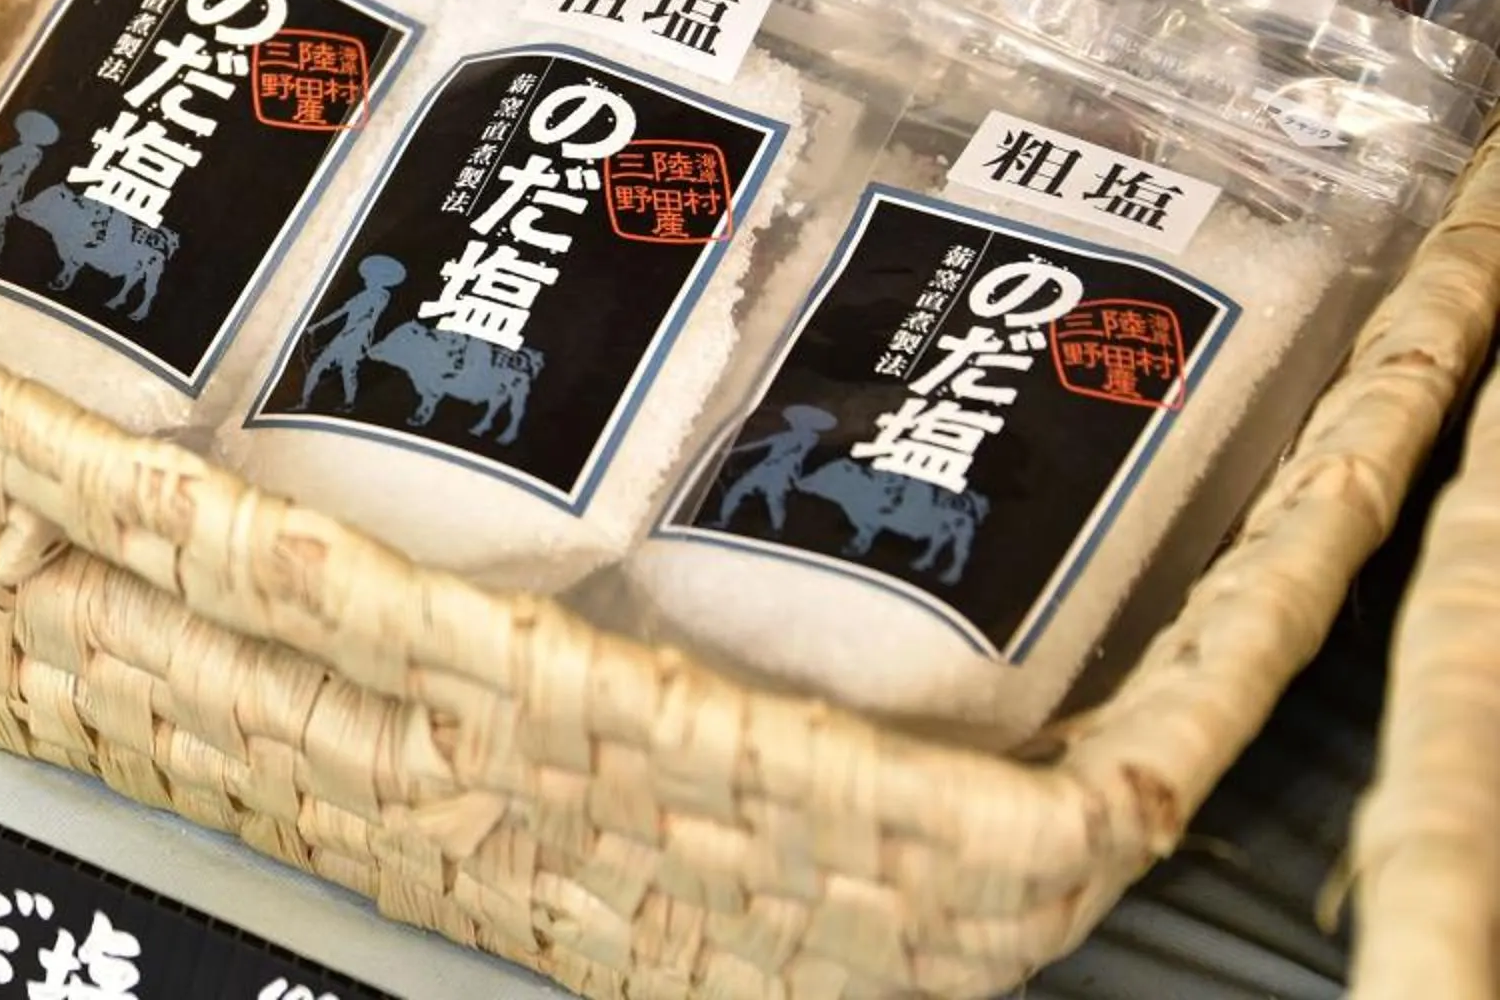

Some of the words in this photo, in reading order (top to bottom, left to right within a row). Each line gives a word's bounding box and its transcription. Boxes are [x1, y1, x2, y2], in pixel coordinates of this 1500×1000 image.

[419, 79, 637, 351] のだ塩
[982, 128, 1184, 233] 粗塩
[851, 256, 1083, 494] のだ塩
